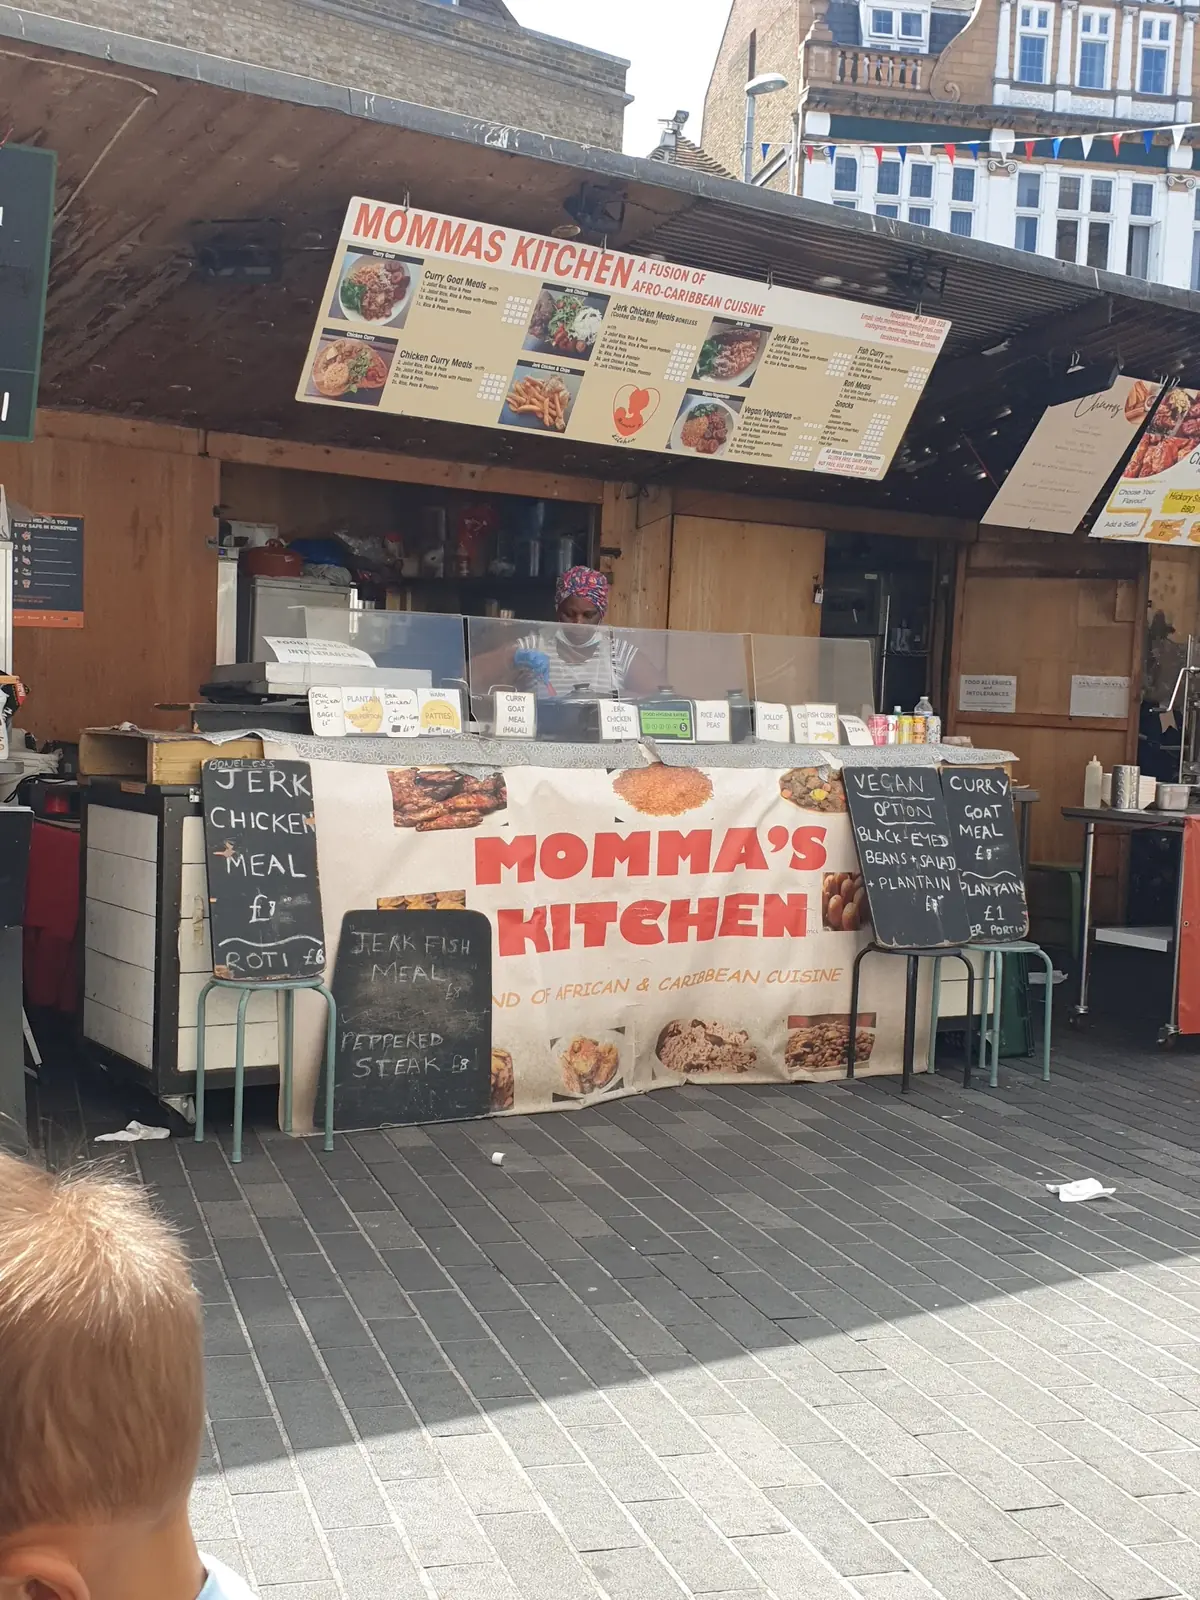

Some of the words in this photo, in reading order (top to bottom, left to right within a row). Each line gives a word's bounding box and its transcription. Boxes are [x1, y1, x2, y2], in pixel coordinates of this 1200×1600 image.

[353, 203, 506, 262] MOMMAS
[511, 235, 635, 292] KITCHEN
[373, 250, 384, 258] Curry
[425, 270, 445, 282] Curry
[447, 275, 464, 284] Goat
[465, 278, 486, 289] Meals
[638, 262, 646, 273] A
[649, 264, 689, 282] FUSION
[691, 273, 707, 285] OF
[631, 279, 723, 309] AFRO-CARIBBEAN
[724, 298, 766, 316] CUISINE
[613, 303, 628, 313] Jerk
[629, 305, 655, 318] Chicken
[656, 311, 675, 322] Meals
[787, 336, 800, 344] Fish
[400, 350, 429, 362] Chicken
[430, 355, 450, 366] Curry
[451, 359, 473, 369] Meals
[857, 346, 869, 356] Fish
[870, 349, 885, 358] Curry
[855, 382, 871, 390] Meals
[835, 400, 854, 409] Snacks
[1169, 492, 1193, 503] Hickory
[1181, 505, 1195, 513] BBQ
[505, 694, 527, 703] CURRY
[508, 705, 525, 713] GOAT
[508, 715, 525, 723] MEAL
[502, 726, 528, 735] (HALAL)
[209, 760, 276, 770] BONELESS
[215, 769, 311, 797] JERK
[853, 773, 925, 793] VEGAN
[950, 775, 1009, 796] CURRY
[874, 801, 933, 819] OPTION
[965, 804, 1002, 819] GOAT
[210, 807, 317, 835] CHICKEN
[959, 823, 1003, 840] MEAL
[474, 825, 828, 885] MOMMA'S
[865, 849, 907, 865] BEANS
[910, 855, 917, 863] +
[920, 855, 957, 871] SALAD
[226, 853, 307, 878] MEAL
[867, 880, 875, 888] +
[879, 875, 951, 891] PLANTAIN
[960, 880, 1025, 897] PLANTAIN
[984, 905, 1005, 921] £1
[497, 892, 807, 957] KITCHEN
[970, 923, 984, 937] ER
[990, 923, 1027, 936] PORTION
[424, 936, 471, 955] FISH
[226, 952, 288, 972] ROTI
[530, 987, 552, 1007] OF
[555, 976, 631, 1002] AFRICAN
[636, 977, 650, 993] &
[658, 965, 762, 993] CARIBBEAN
[765, 967, 844, 986] CUISINE
[340, 1031, 444, 1050] PEPPERED
[353, 1057, 442, 1080] STEAK
[451, 1055, 470, 1073] £8
